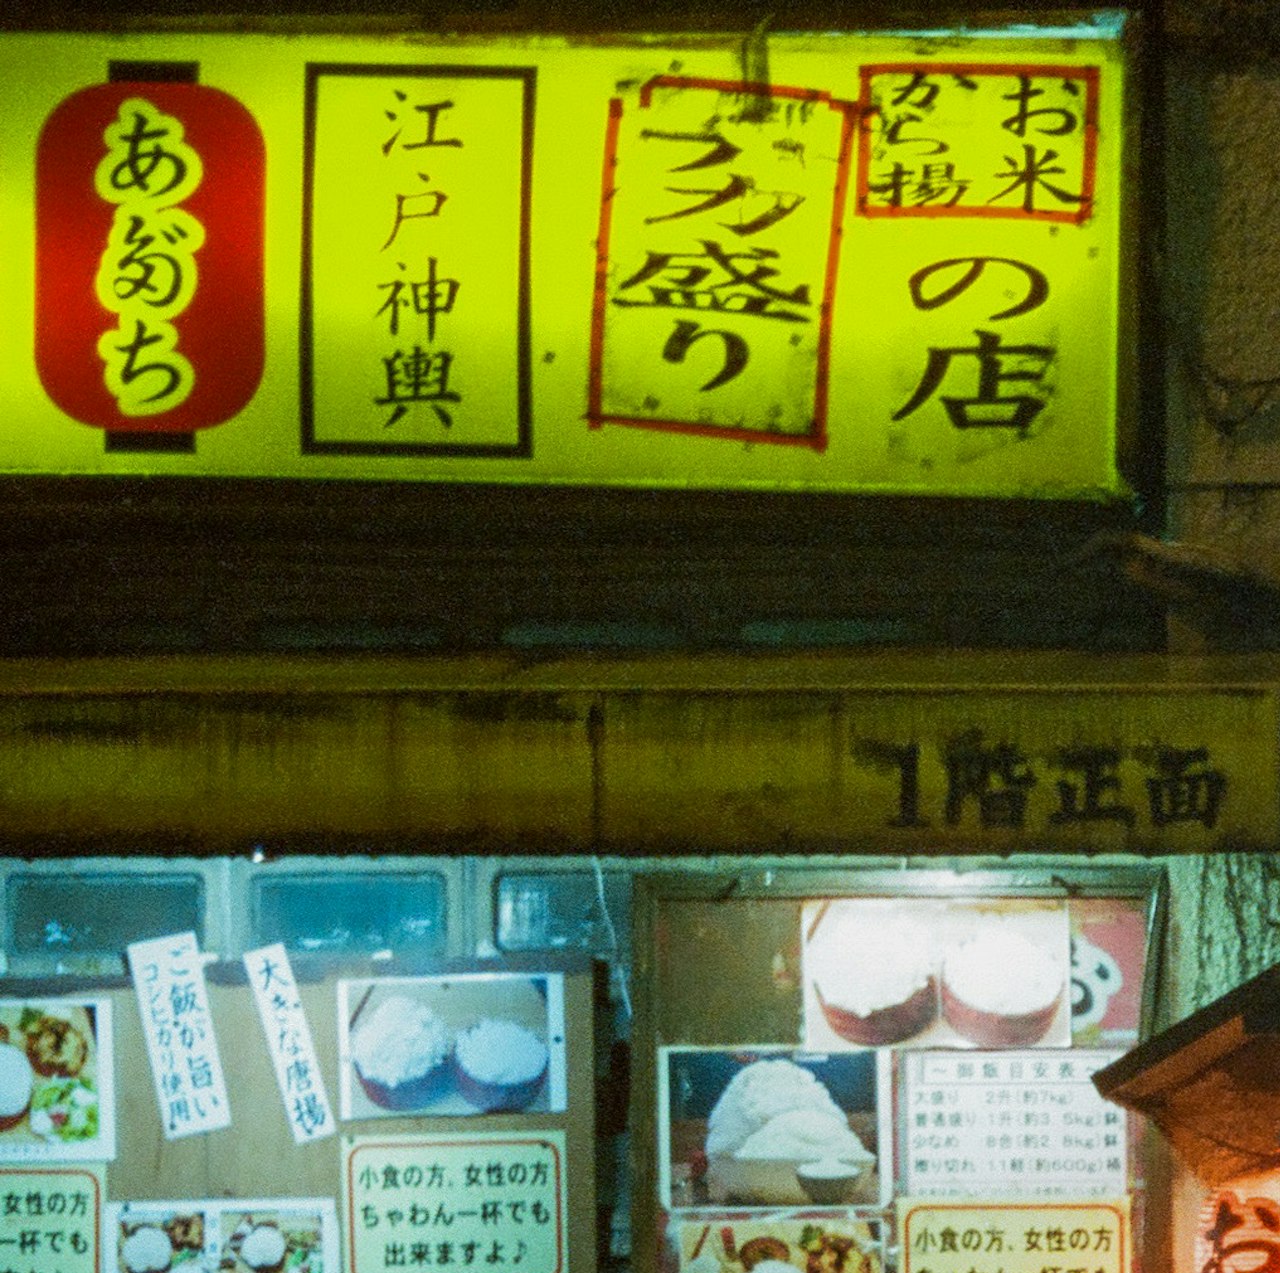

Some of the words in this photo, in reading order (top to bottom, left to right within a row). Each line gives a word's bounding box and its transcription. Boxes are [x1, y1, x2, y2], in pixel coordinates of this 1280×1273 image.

[986, 76, 1084, 211] お米
[372, 88, 465, 431] 江戸神輿
[890, 255, 1058, 436] の店
[361, 1200, 551, 1228] ちゃわん一杯でも
